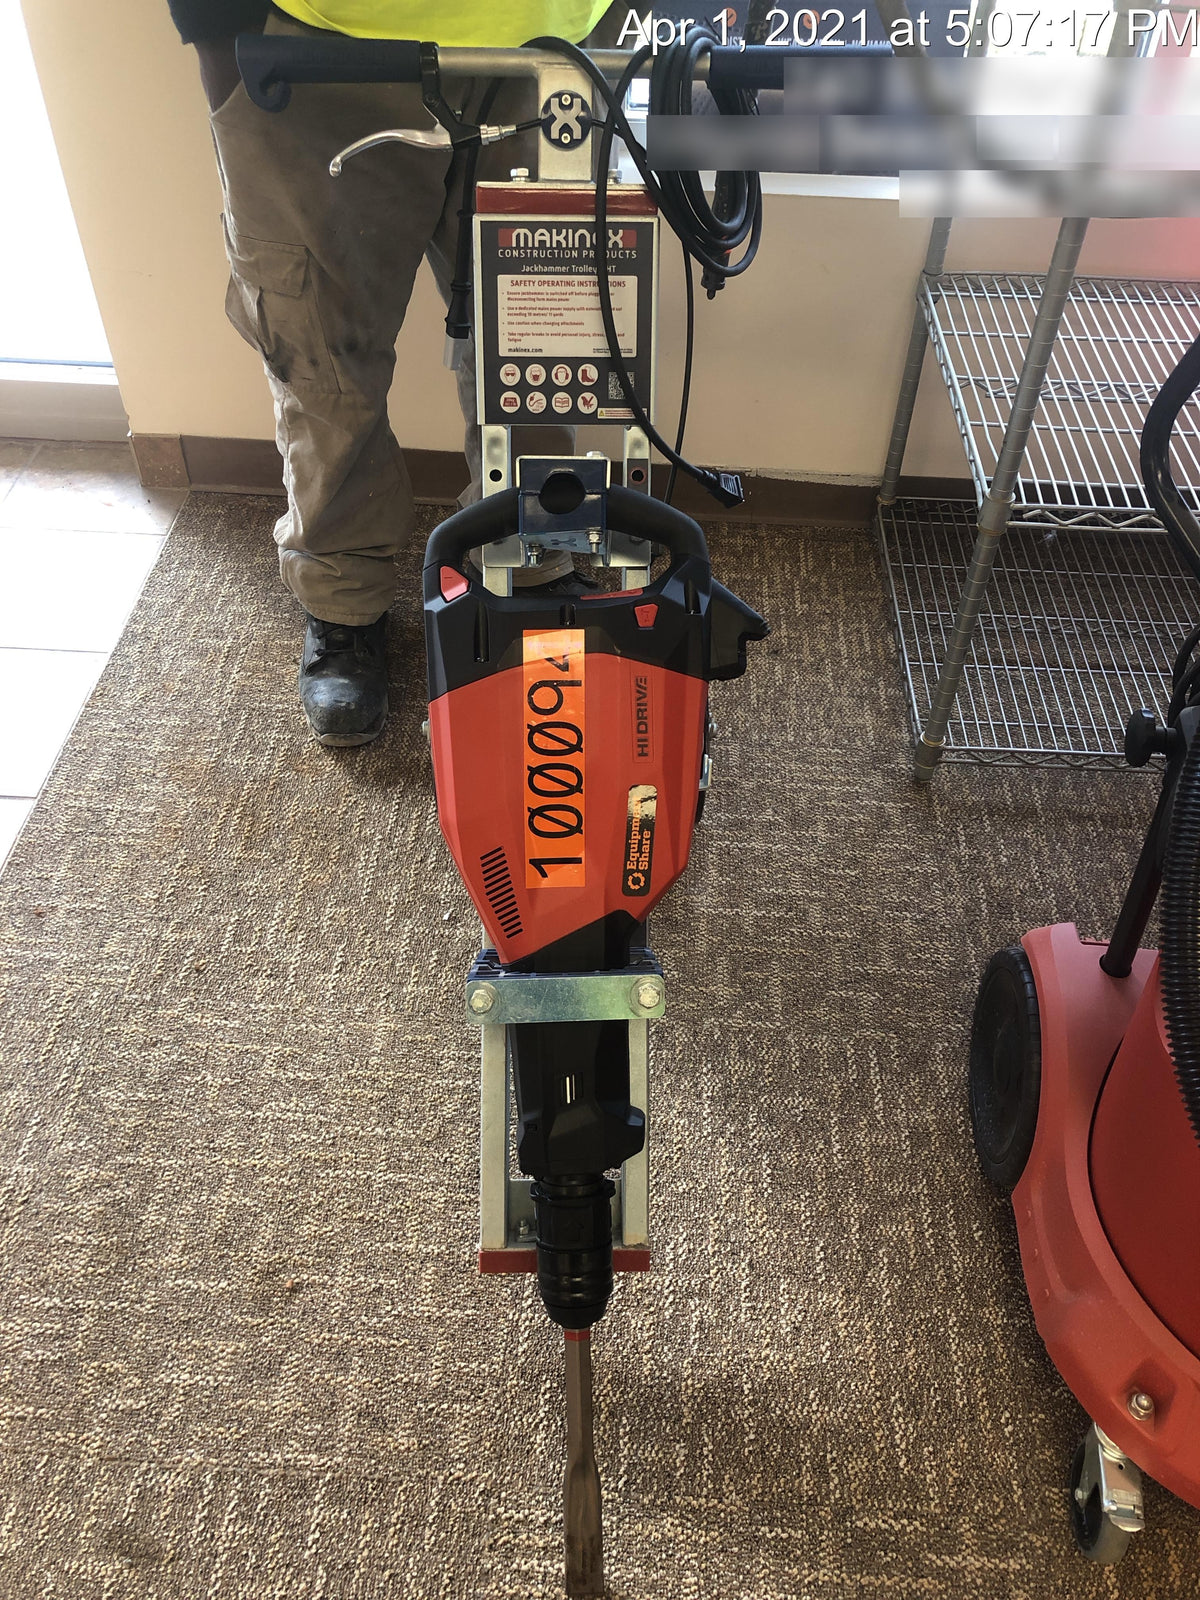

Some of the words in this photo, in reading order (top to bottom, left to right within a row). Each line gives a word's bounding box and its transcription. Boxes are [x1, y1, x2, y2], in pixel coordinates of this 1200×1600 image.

[512, 228, 623, 248] MAKINX
[498, 249, 578, 258] CONSTRUCTION
[582, 249, 637, 259] PRUCTS
[521, 264, 570, 272] Jackhammer
[571, 264, 598, 274] Trolley
[537, 280, 576, 288] OPERATING
[635, 677, 648, 735] DRIVE
[637, 738, 649, 757] HI
[638, 829, 652, 870] Share
